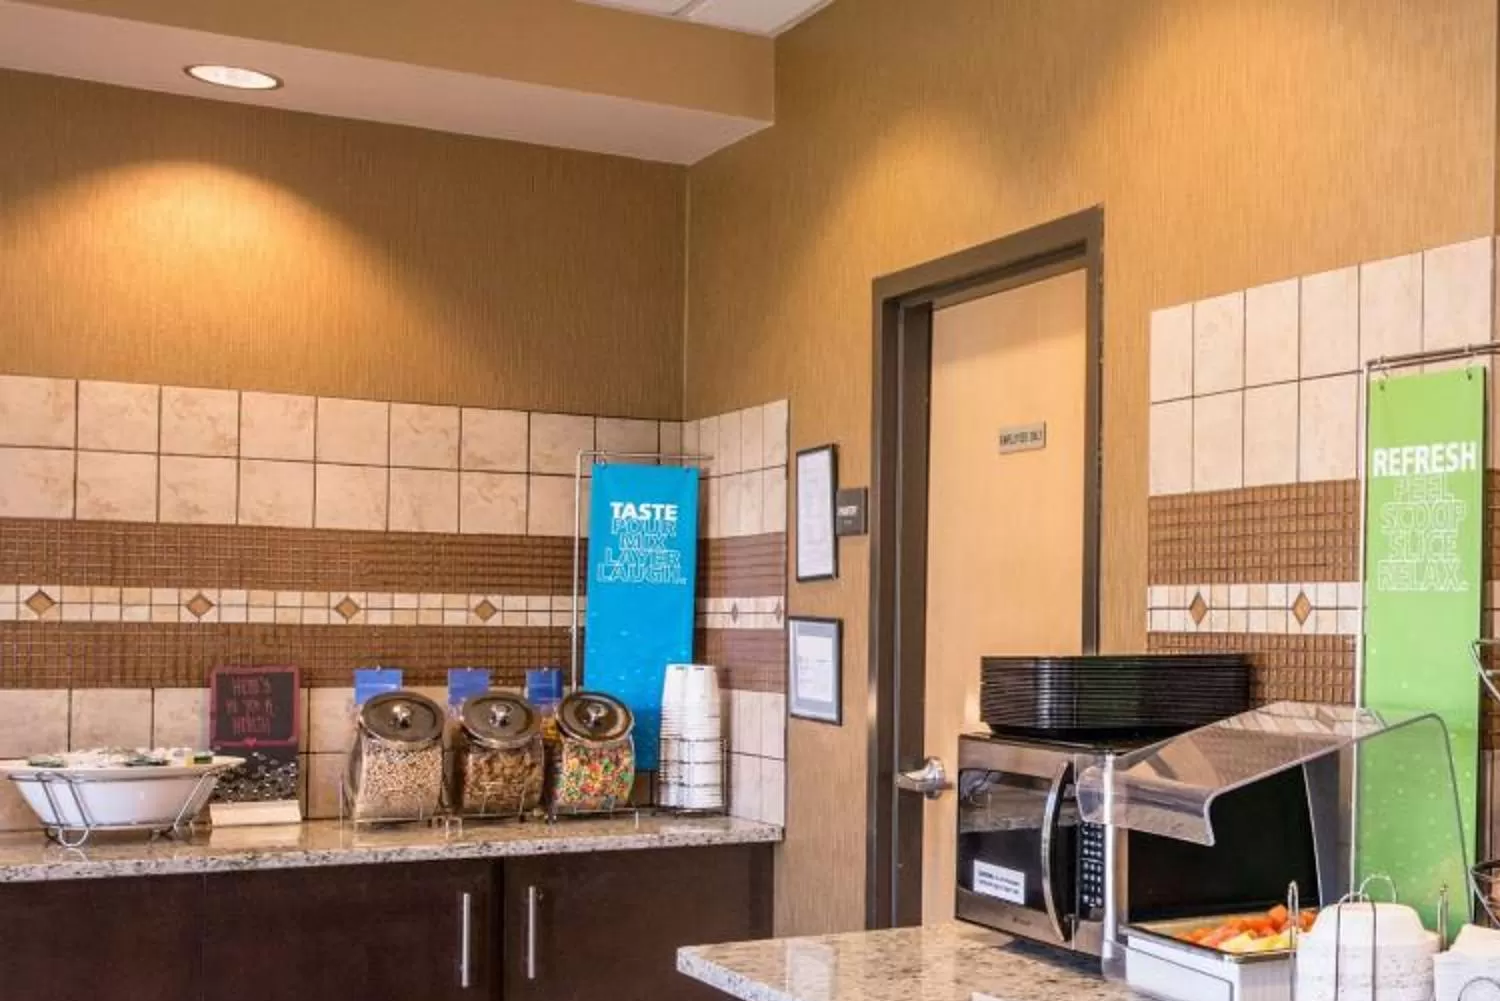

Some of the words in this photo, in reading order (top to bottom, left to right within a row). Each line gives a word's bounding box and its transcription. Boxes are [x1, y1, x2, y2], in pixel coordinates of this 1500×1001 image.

[1373, 441, 1476, 477] REFRESH
[1393, 472, 1455, 503] PEEL
[609, 502, 678, 520] TASTE
[1388, 530, 1458, 561] SLICE
